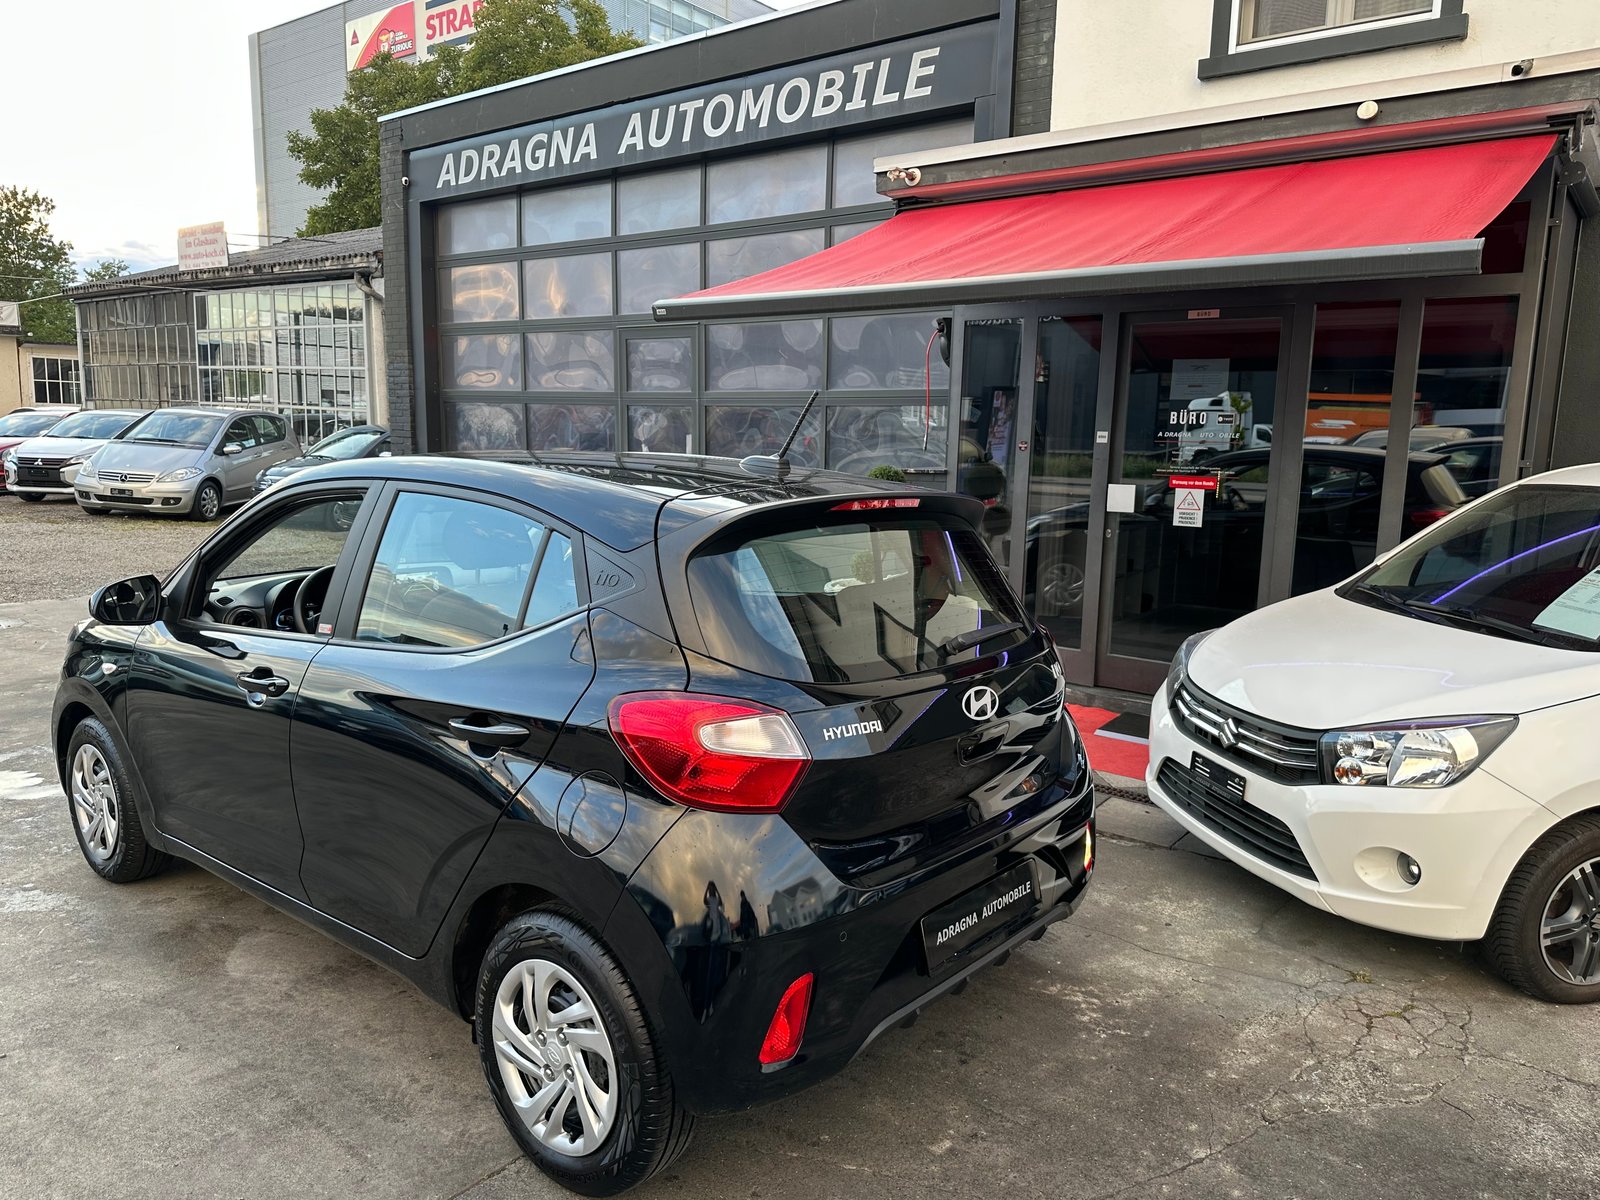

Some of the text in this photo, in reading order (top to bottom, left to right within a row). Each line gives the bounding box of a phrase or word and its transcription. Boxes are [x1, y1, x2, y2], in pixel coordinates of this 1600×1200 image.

[436, 47, 941, 189] ADRAGNA AUTOMOBILE
[1170, 409, 1207, 425] BÜRO
[593, 570, 620, 588] i10
[823, 719, 883, 741] HYUNDAI
[936, 881, 1031, 946] ADRAGNA AUTOMOBILE
